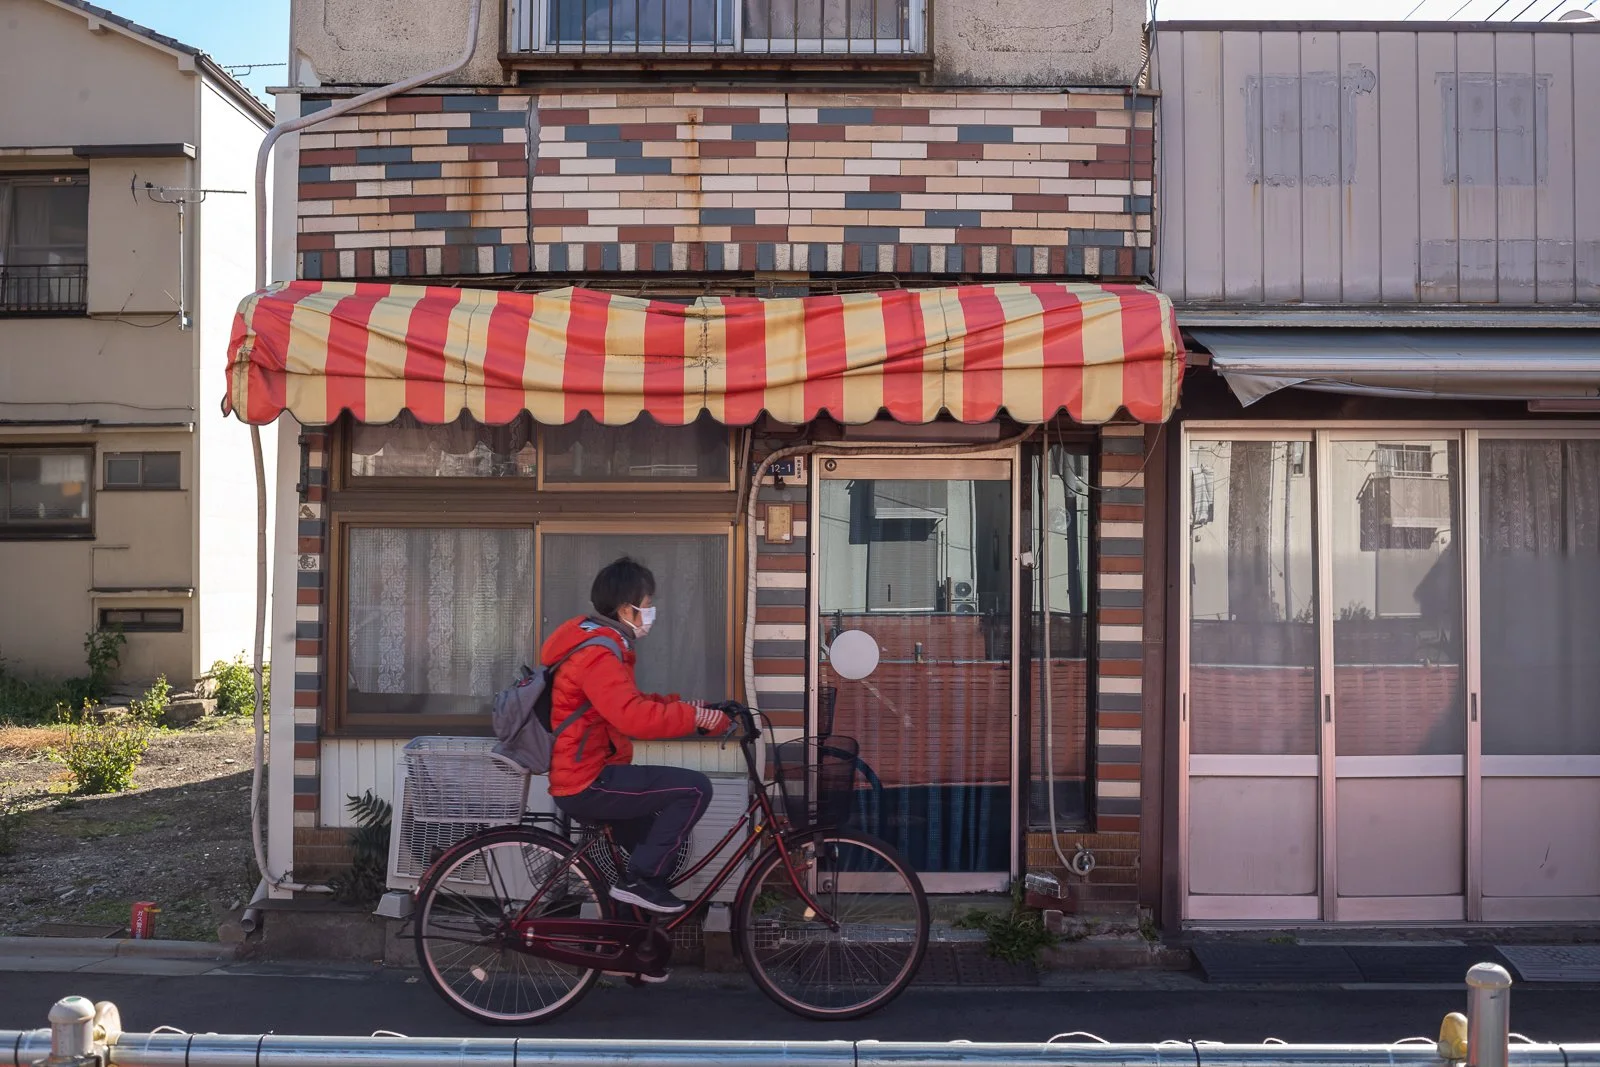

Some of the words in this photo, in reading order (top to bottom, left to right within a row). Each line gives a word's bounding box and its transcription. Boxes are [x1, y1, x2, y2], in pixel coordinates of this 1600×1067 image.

[770, 464, 791, 473] 12-1
[135, 910, 144, 938] ガス管注
